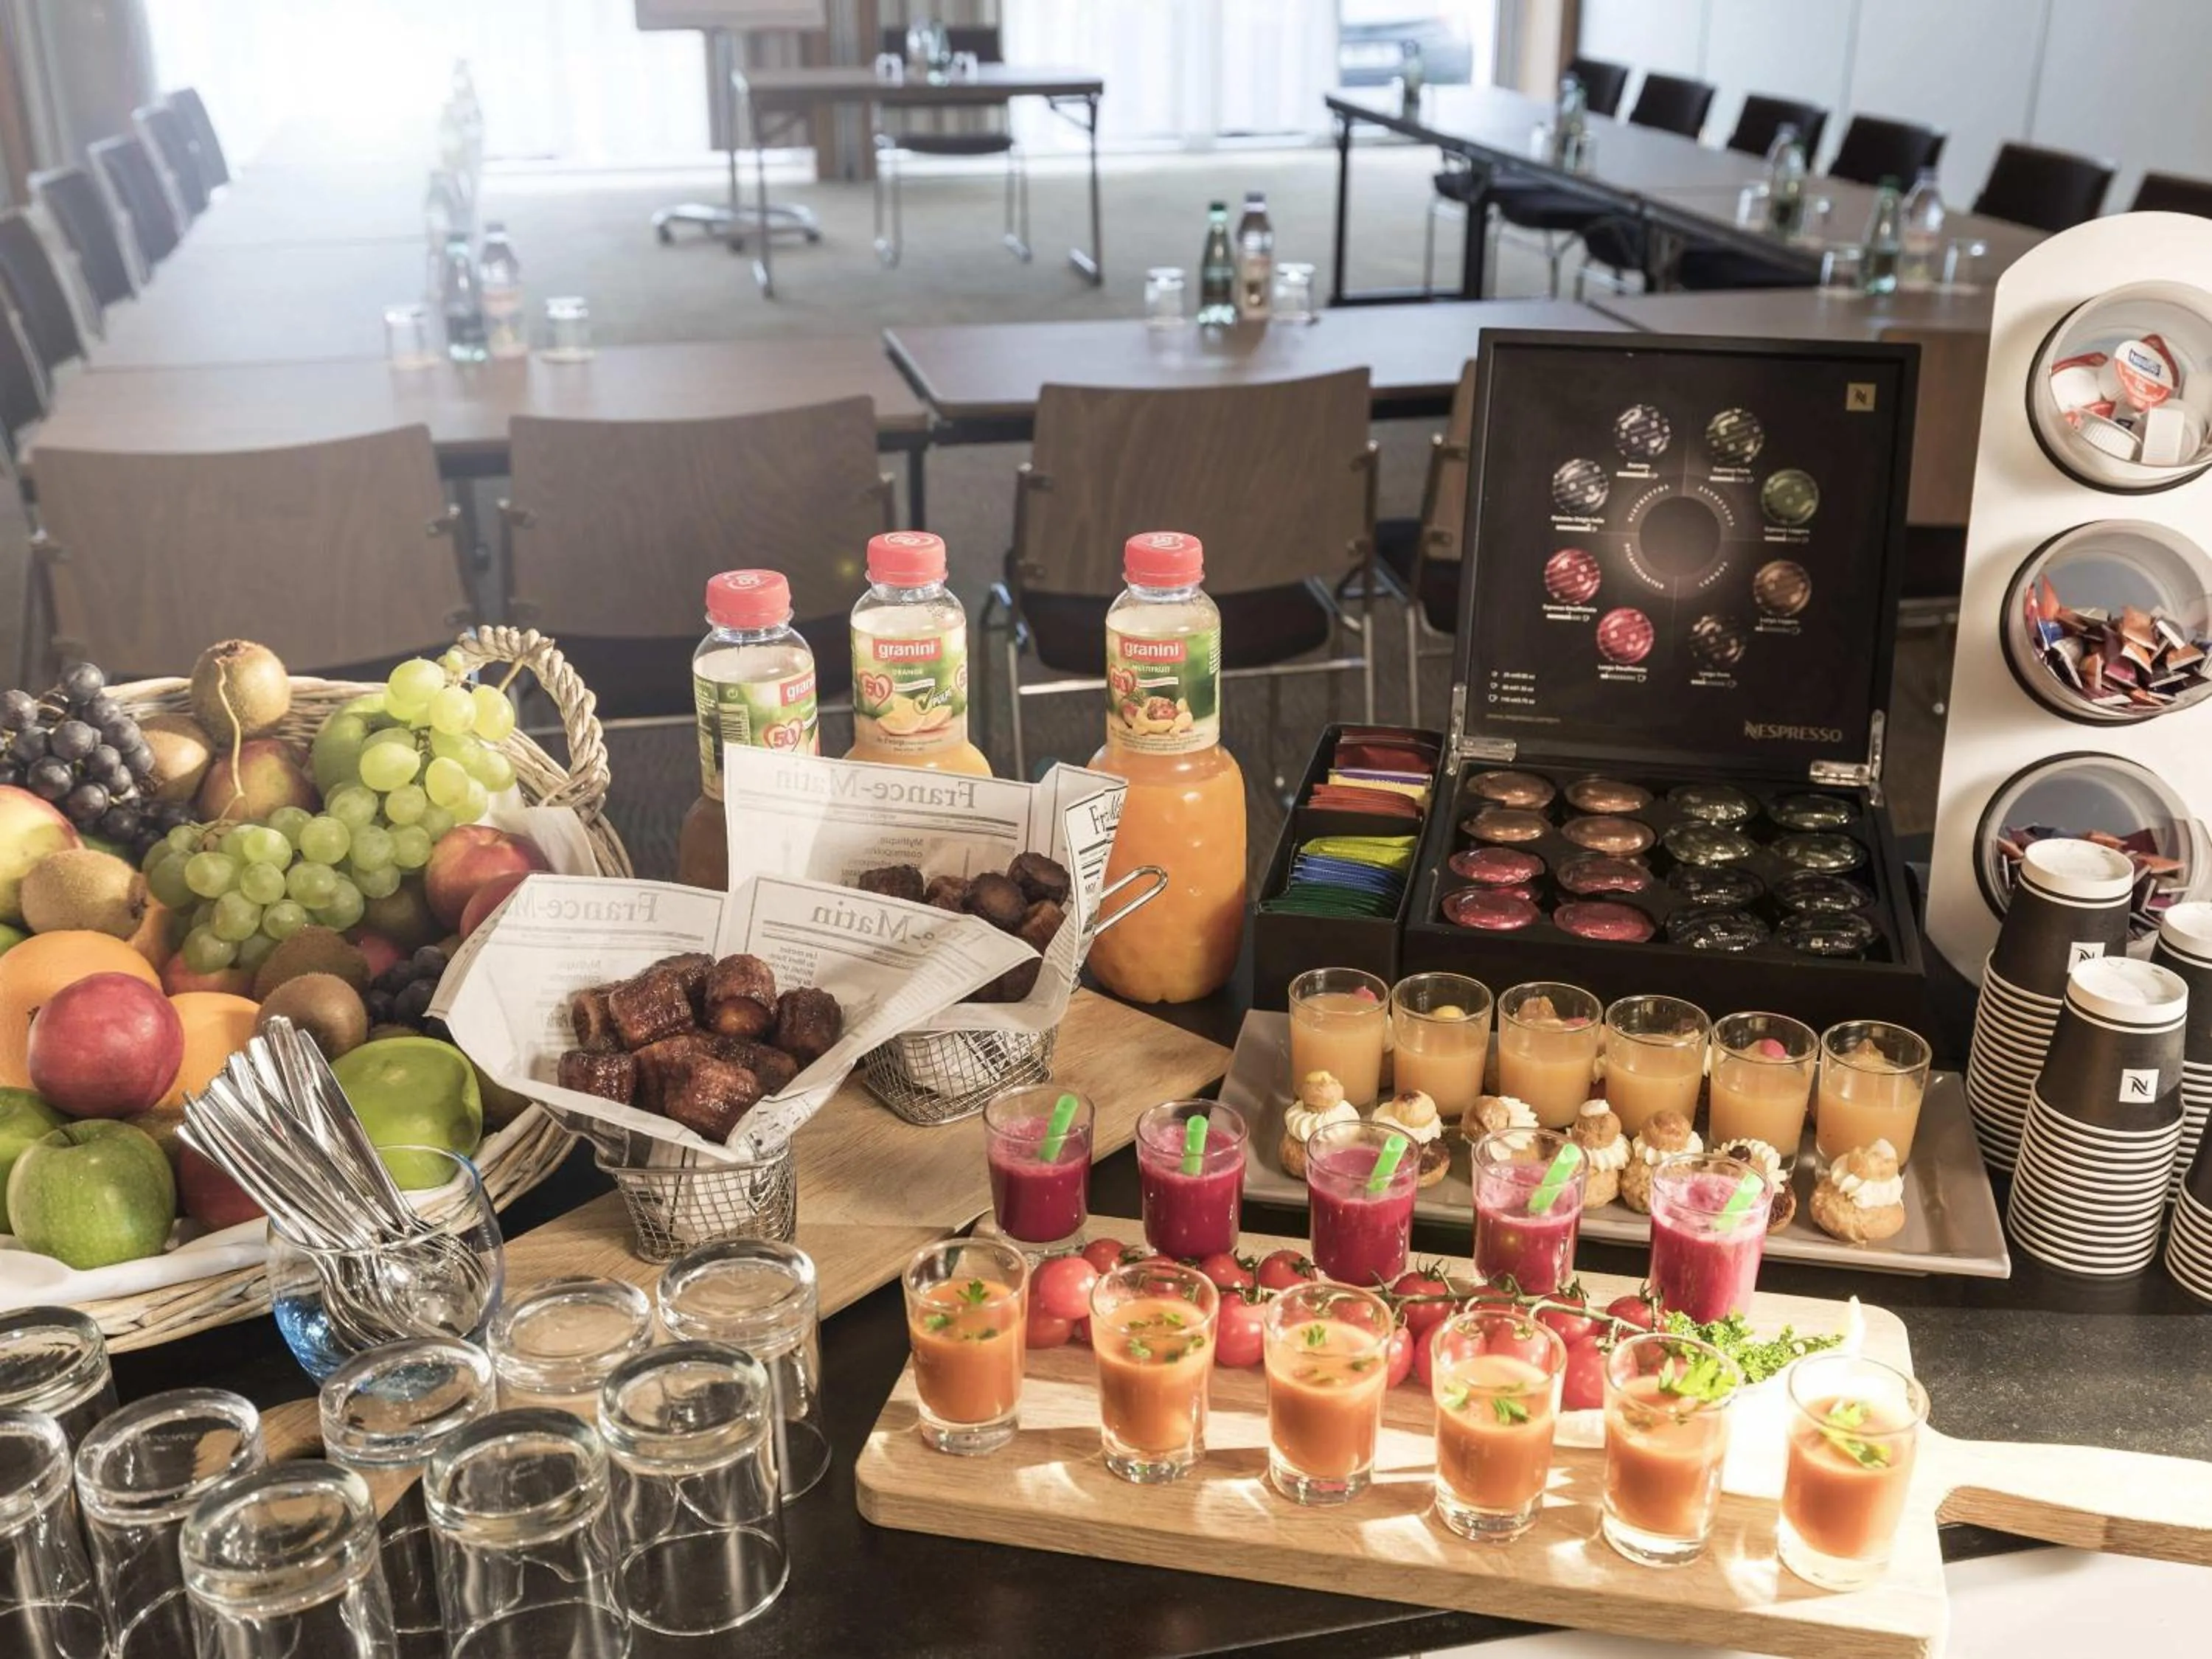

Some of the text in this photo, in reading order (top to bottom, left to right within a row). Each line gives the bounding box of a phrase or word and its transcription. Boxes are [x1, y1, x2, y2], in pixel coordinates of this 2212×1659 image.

[878, 641, 935, 658] granini
[1124, 641, 1180, 658] granini
[786, 677, 815, 702] gran
[865, 679, 885, 698] 50
[774, 728, 796, 748] 50
[1745, 720, 1843, 742] NESPRESSO
[2126, 1076, 2152, 1096] N
